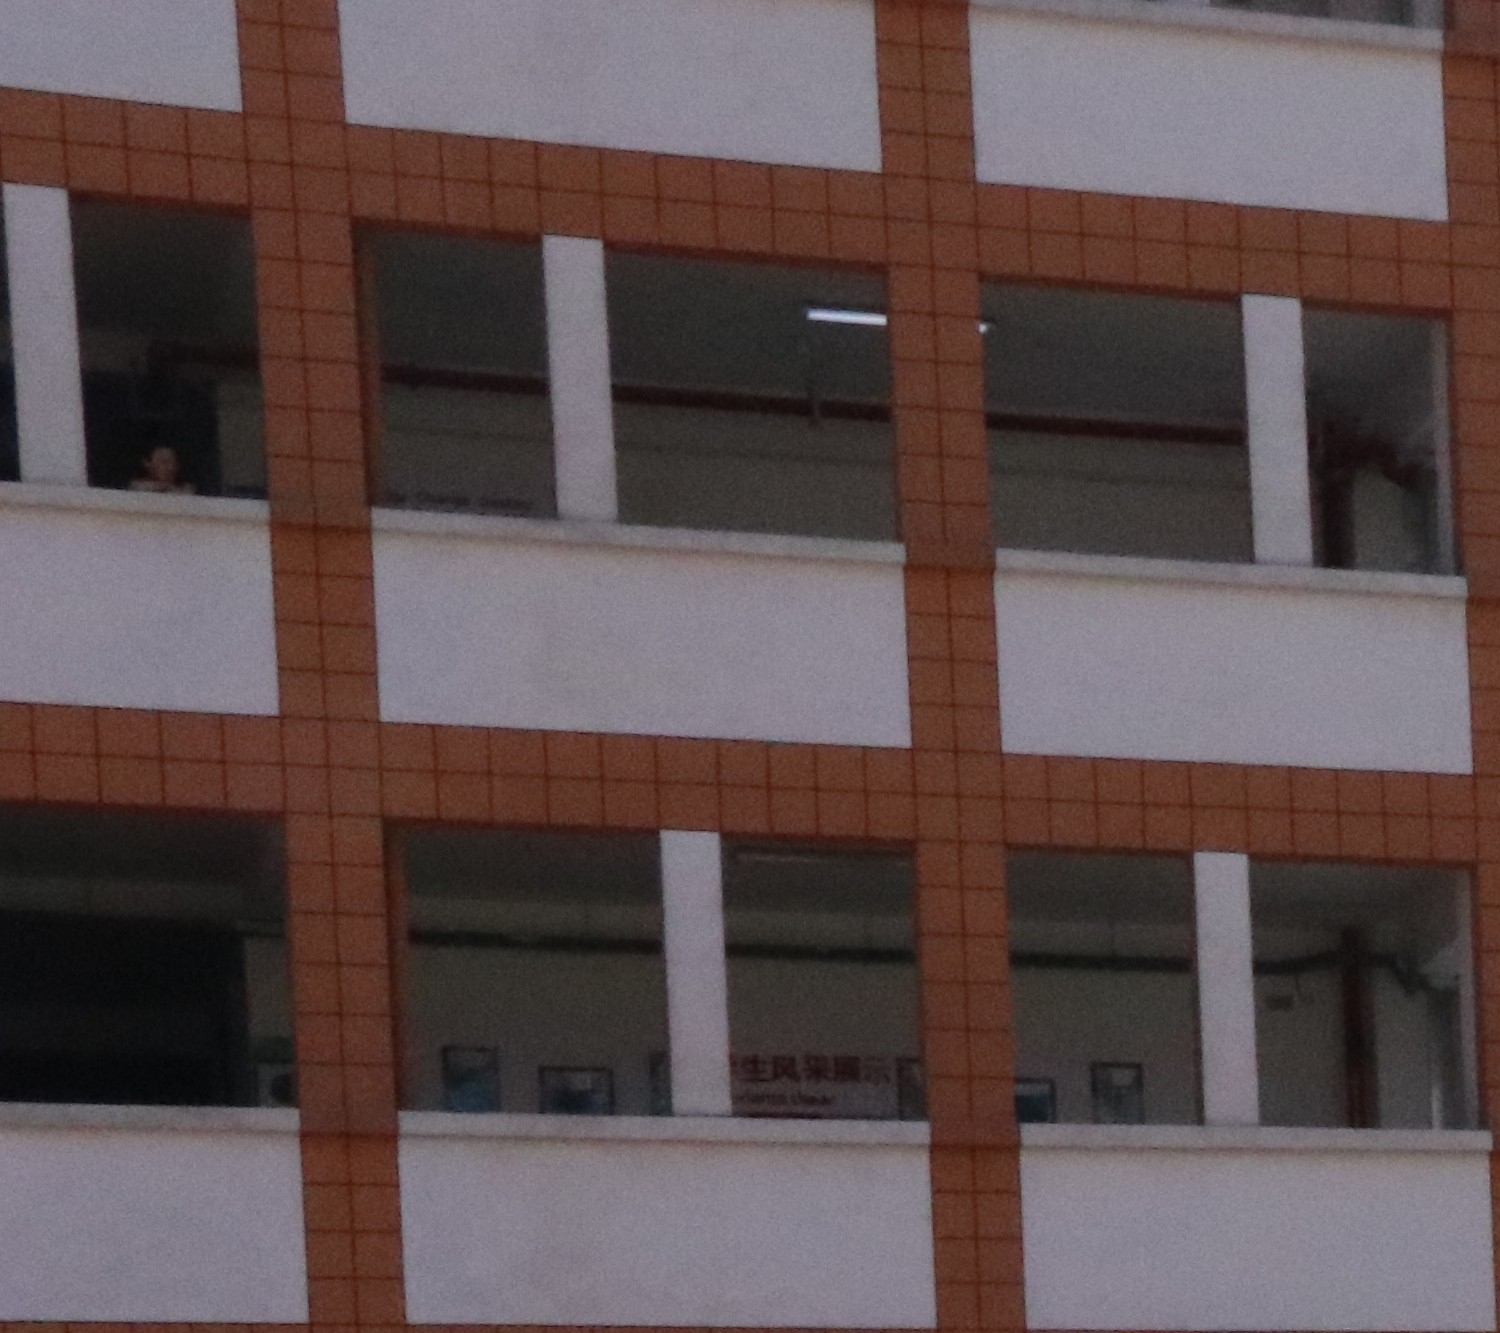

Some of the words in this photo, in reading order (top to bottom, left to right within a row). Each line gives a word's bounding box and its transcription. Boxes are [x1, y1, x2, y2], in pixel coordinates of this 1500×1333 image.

[729, 1054, 891, 1085] 生风采展示
